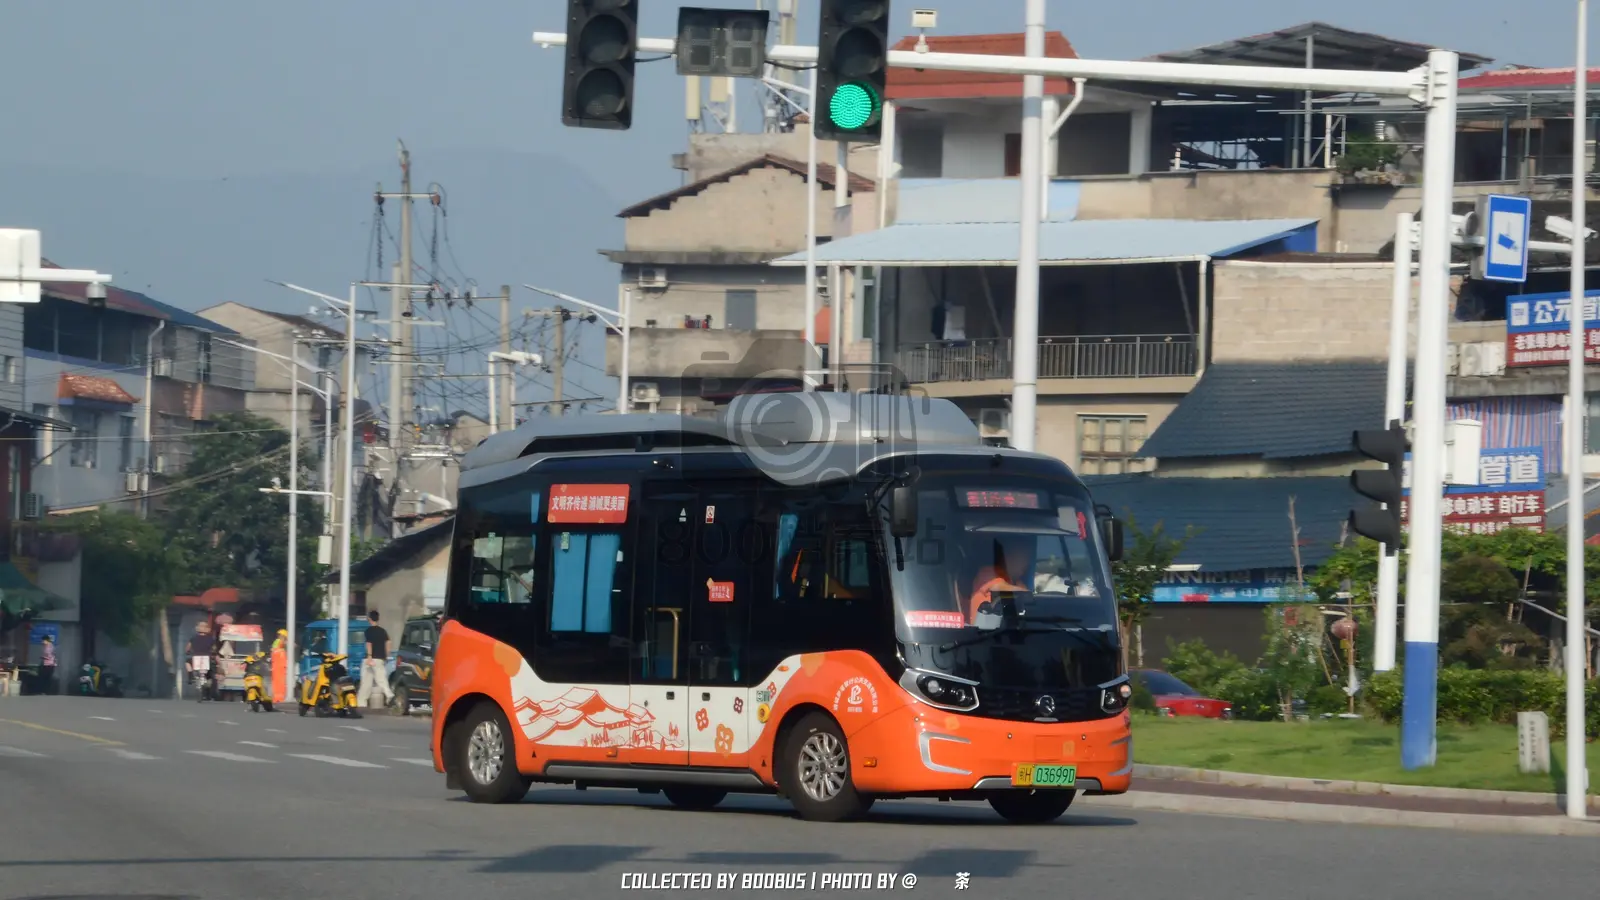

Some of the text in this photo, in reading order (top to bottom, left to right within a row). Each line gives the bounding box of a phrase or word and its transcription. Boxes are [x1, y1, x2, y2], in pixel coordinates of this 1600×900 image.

[1479, 454, 1539, 484] 管道
[1499, 493, 1540, 514] 自行车
[1036, 767, 1075, 783] 03699D
